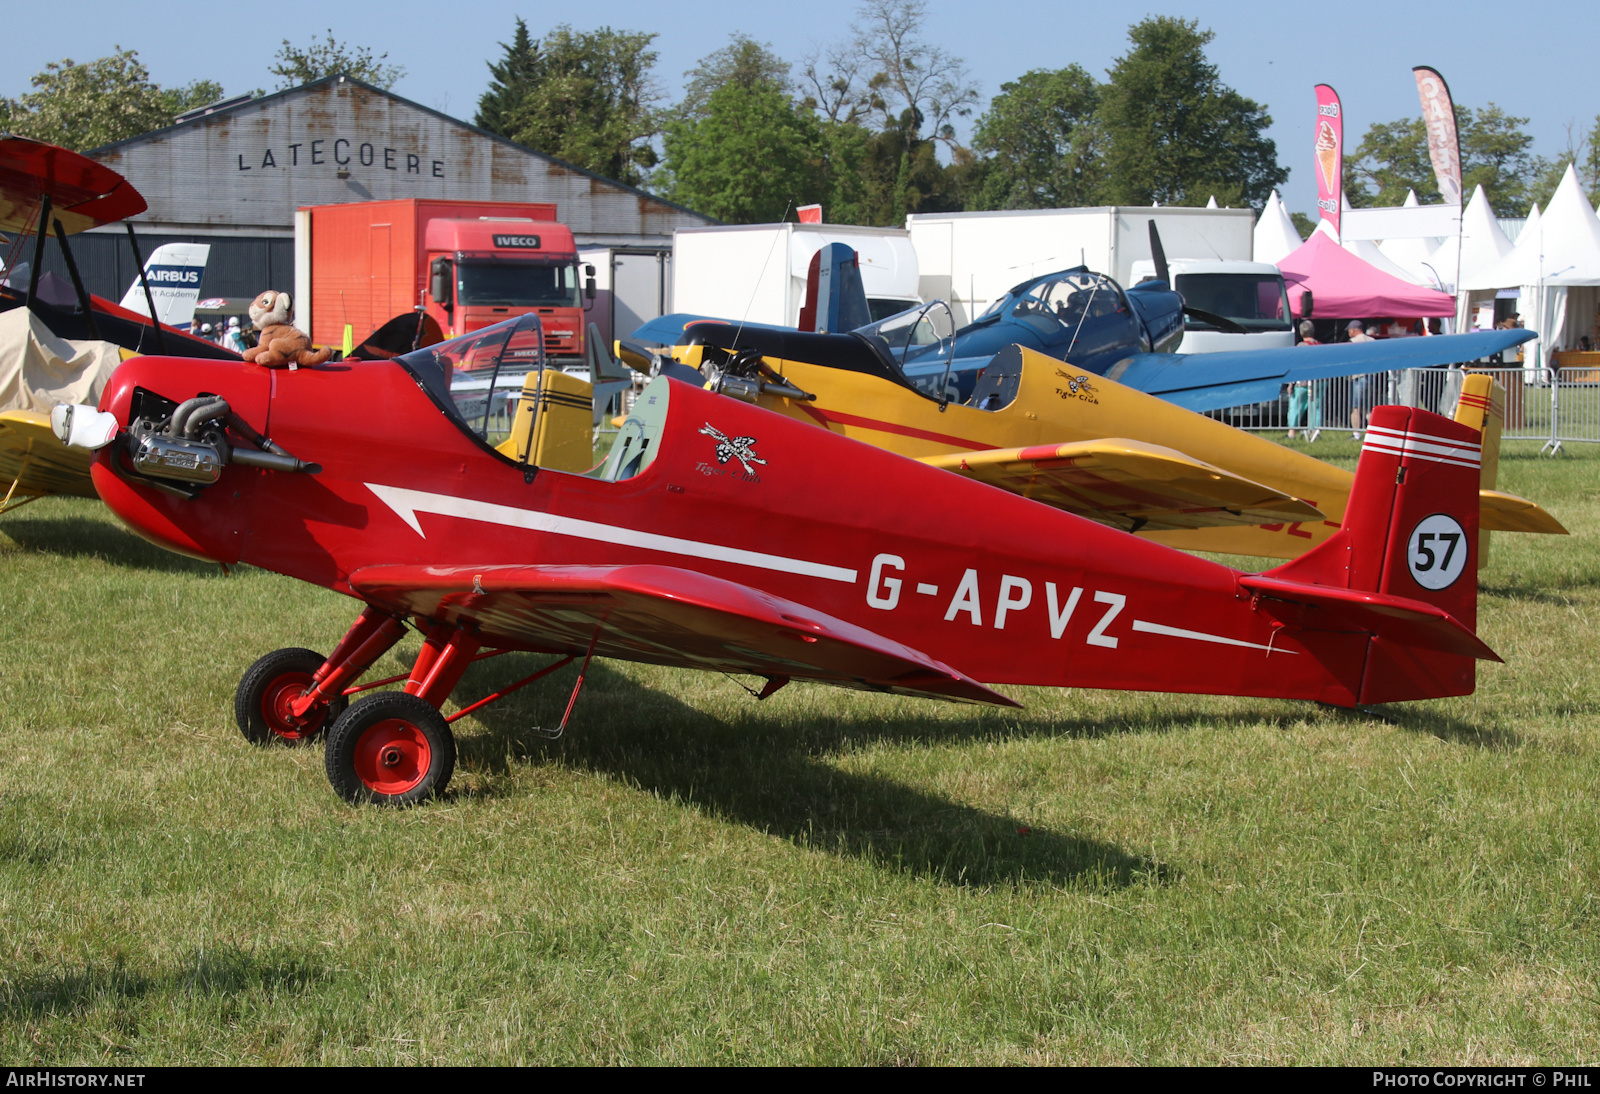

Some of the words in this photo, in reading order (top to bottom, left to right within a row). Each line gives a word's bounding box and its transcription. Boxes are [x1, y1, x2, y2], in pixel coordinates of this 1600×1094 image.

[238, 138, 445, 178] LATECOERE
[497, 236, 537, 246] IVECO
[146, 269, 199, 282] AIRBUS
[160, 290, 198, 300] Academy
[1055, 388, 1077, 399] Tiger
[1078, 394, 1099, 405] Club
[695, 461, 727, 476] Tiger
[731, 470, 761, 484] Club
[1415, 533, 1461, 572] 57
[866, 553, 1127, 649] G-APVZ
